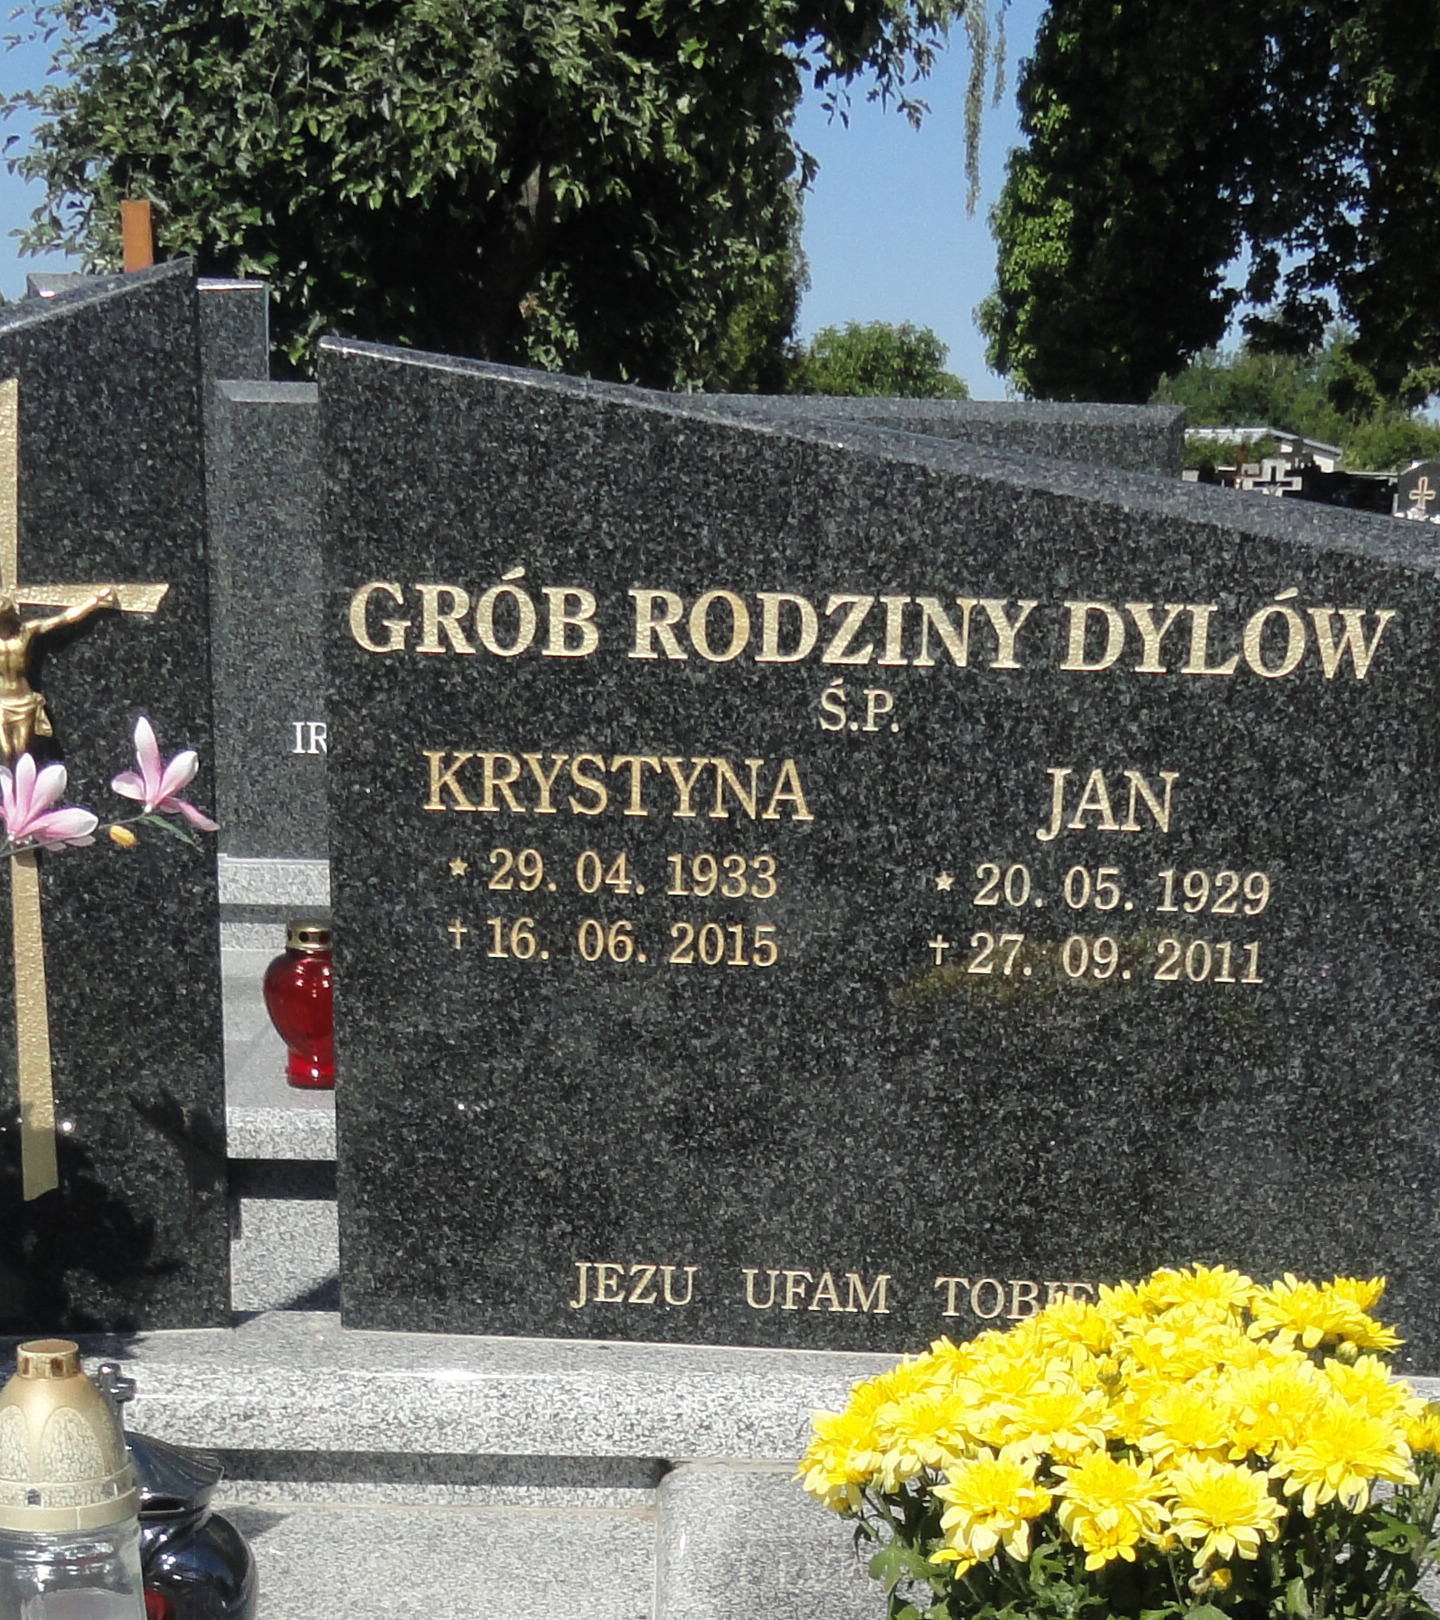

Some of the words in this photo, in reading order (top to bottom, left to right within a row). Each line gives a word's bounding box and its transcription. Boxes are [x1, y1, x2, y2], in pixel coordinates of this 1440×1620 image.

[348, 566, 600, 658] GRÓB
[627, 588, 1039, 670] RODZINY
[1059, 586, 1397, 681] DYLÓW
[818, 678, 901, 733] Ś.P.
[422, 750, 816, 821] KRYSTYNA
[1036, 767, 1180, 842] JAN
[487, 847, 557, 892] 29.
[575, 850, 646, 896] 04.
[666, 853, 778, 899] 1933
[973, 863, 1044, 908] 20.
[1064, 866, 1134, 912] 05.
[1156, 868, 1271, 916] 1929
[486, 917, 550, 960] 16.
[577, 919, 647, 964] 06.
[668, 921, 779, 967] 2015
[967, 932, 1032, 976] 27.
[1061, 935, 1132, 980] 09.
[1153, 939, 1264, 984] 2011
[570, 1262, 698, 1310] JEZU
[742, 1269, 892, 1314] UFAM
